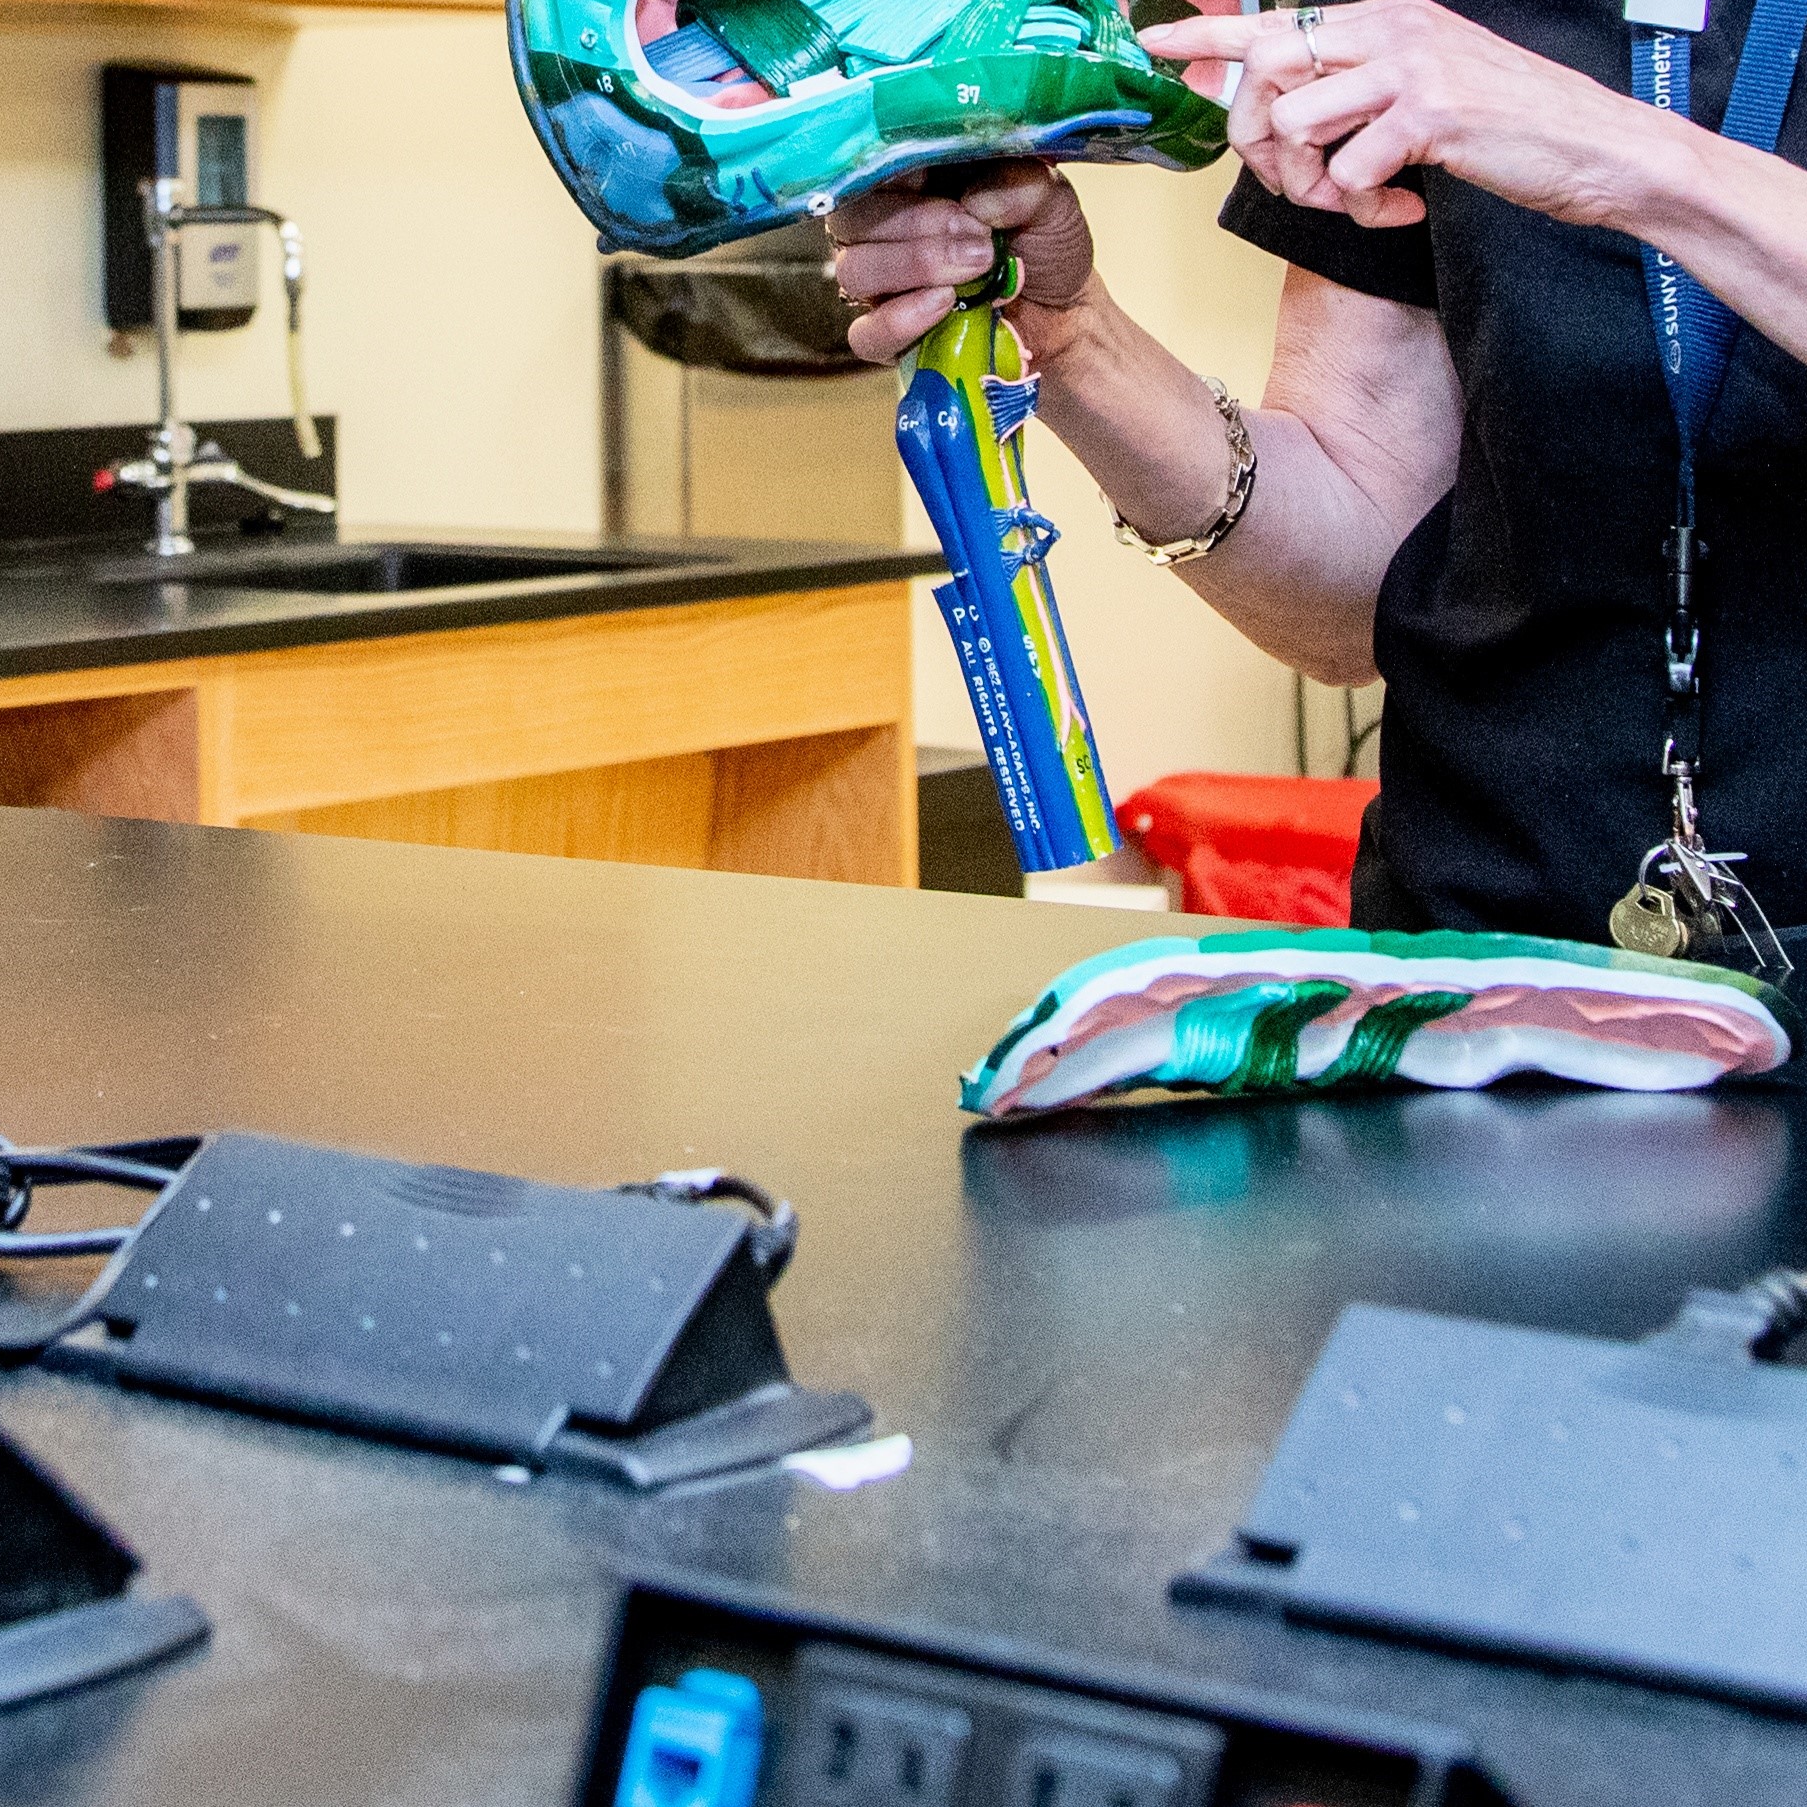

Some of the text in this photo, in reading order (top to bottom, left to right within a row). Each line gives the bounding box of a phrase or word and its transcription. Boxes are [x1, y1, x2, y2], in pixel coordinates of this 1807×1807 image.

[596, 74, 614, 94] 18
[955, 82, 982, 105] 37
[1651, 30, 1676, 112] ometry
[1659, 273, 1680, 337] SUNY
[960, 639, 1026, 832] ALL RIGHTS RESERVED
